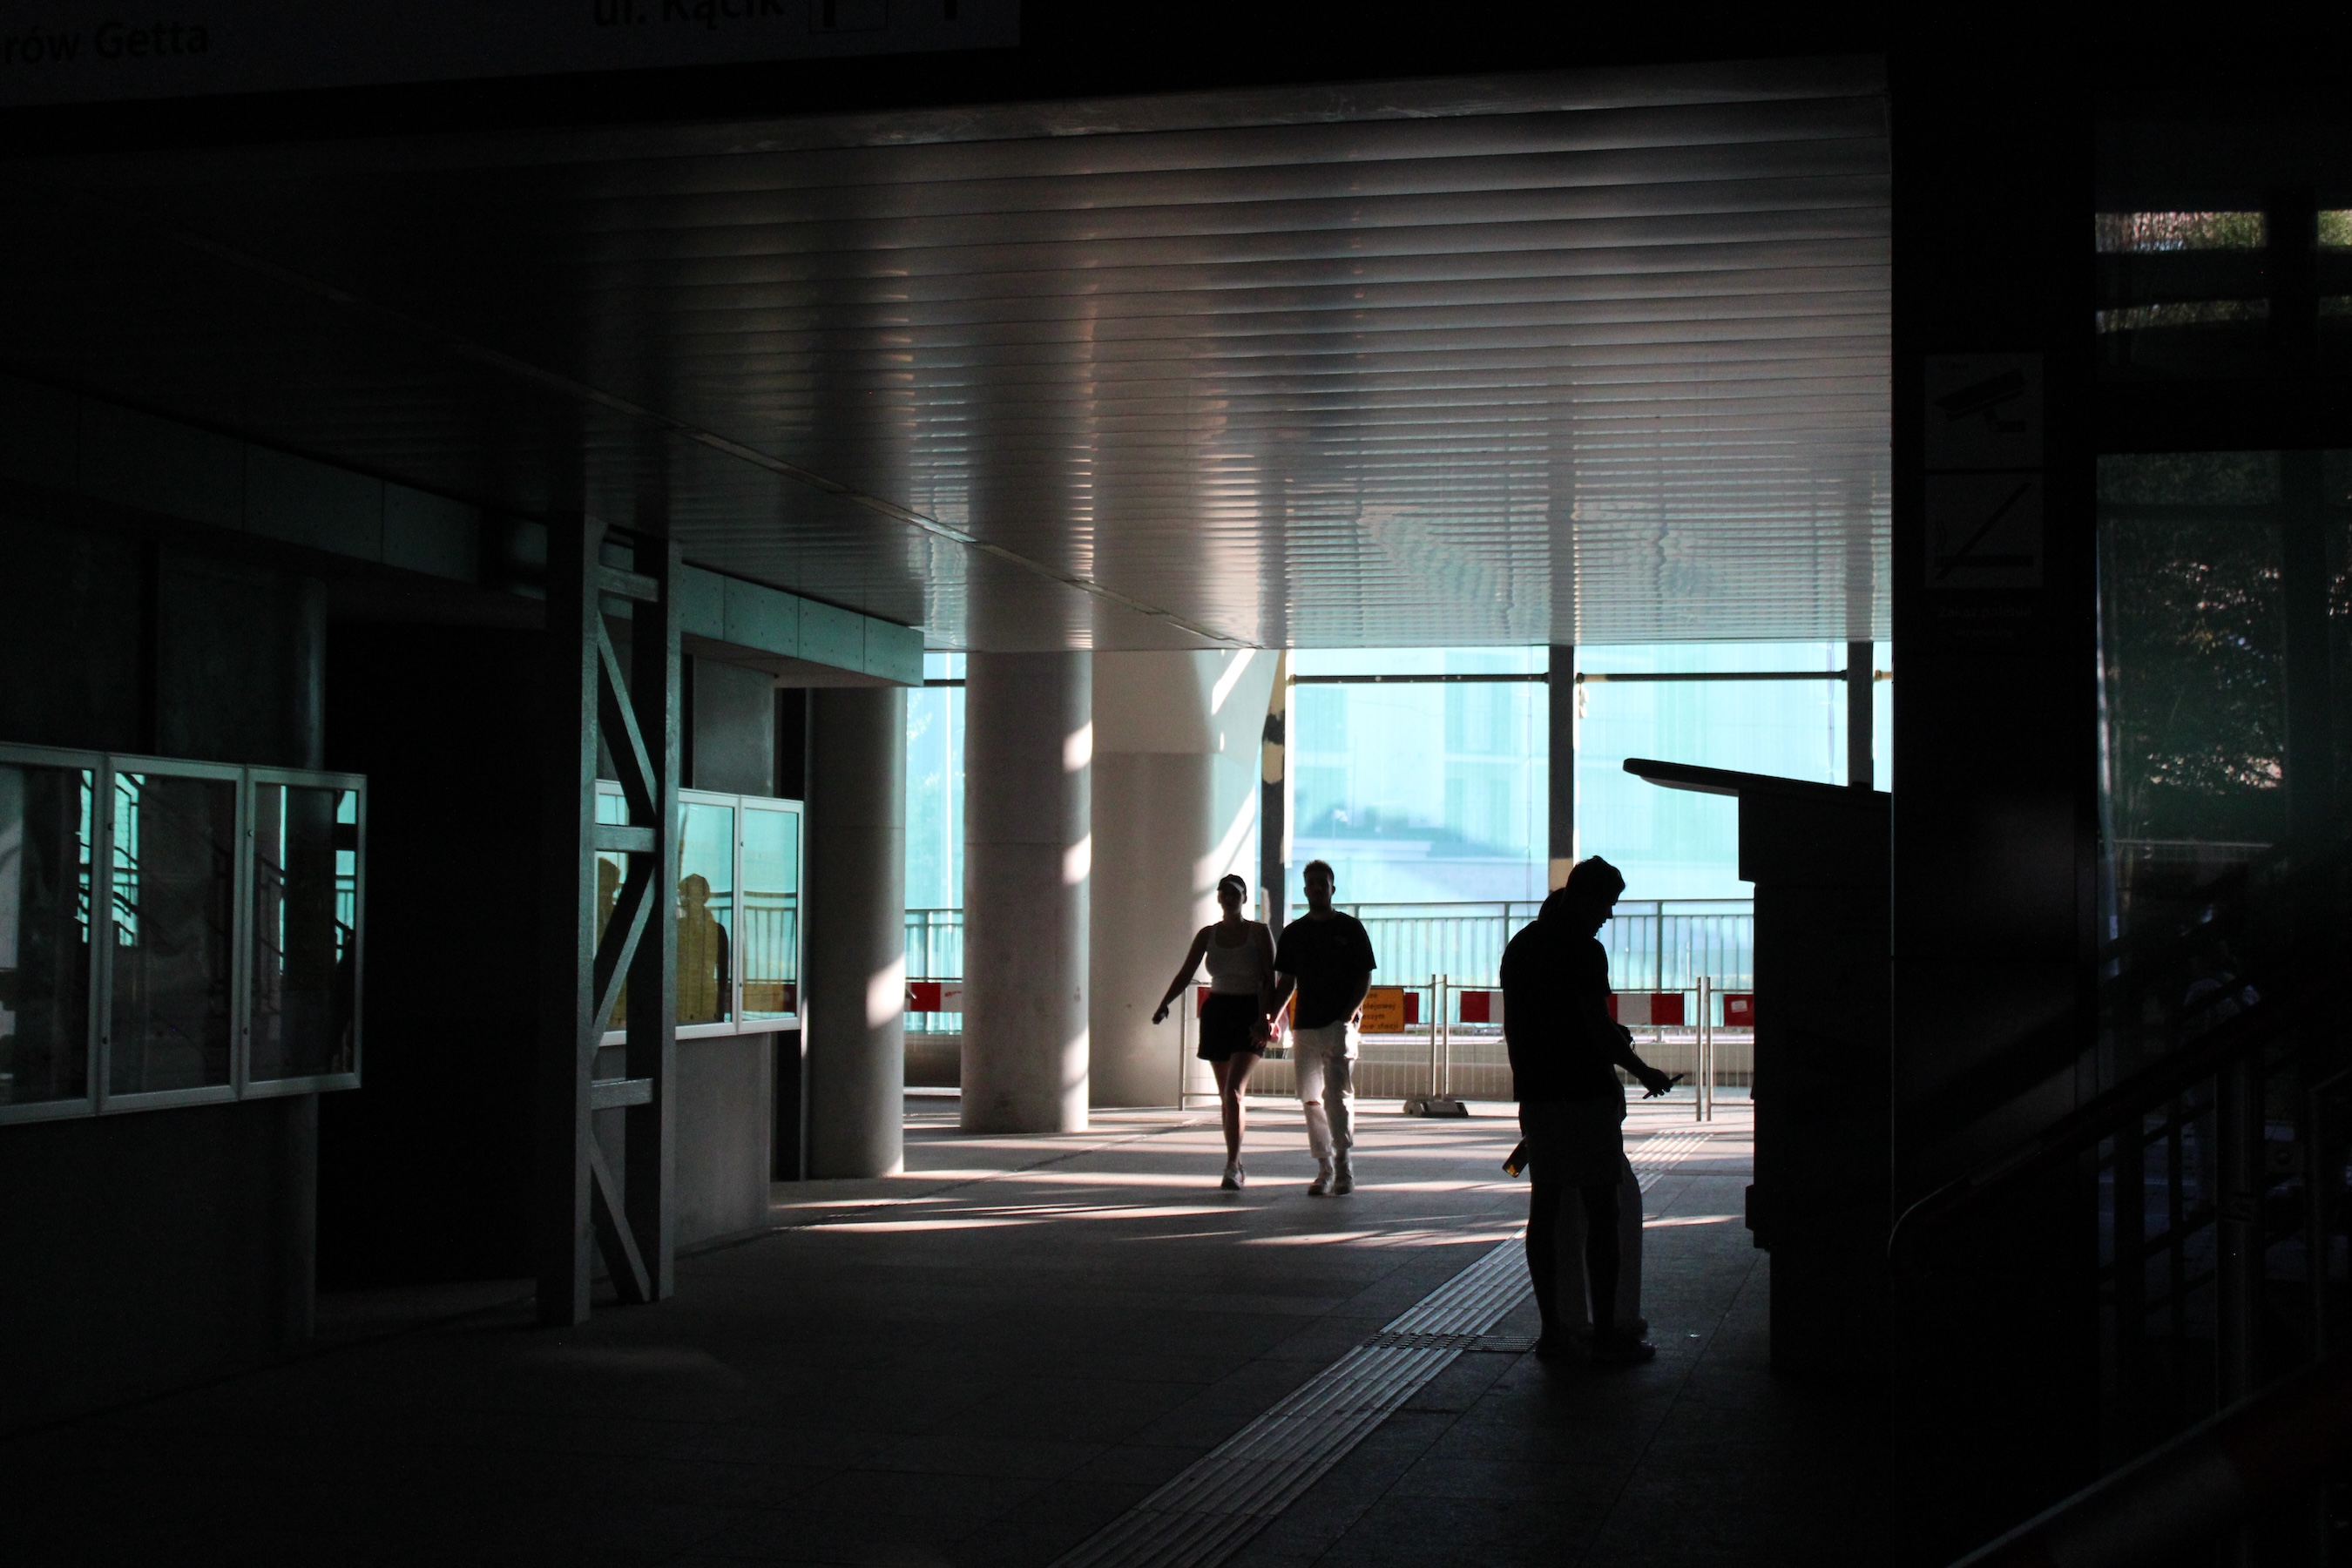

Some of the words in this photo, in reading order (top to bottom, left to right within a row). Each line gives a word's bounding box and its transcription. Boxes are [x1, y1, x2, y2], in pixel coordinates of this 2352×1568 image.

[594, 0, 645, 26] ul.
[4, 24, 81, 65] rów
[94, 21, 208, 58] Getta
